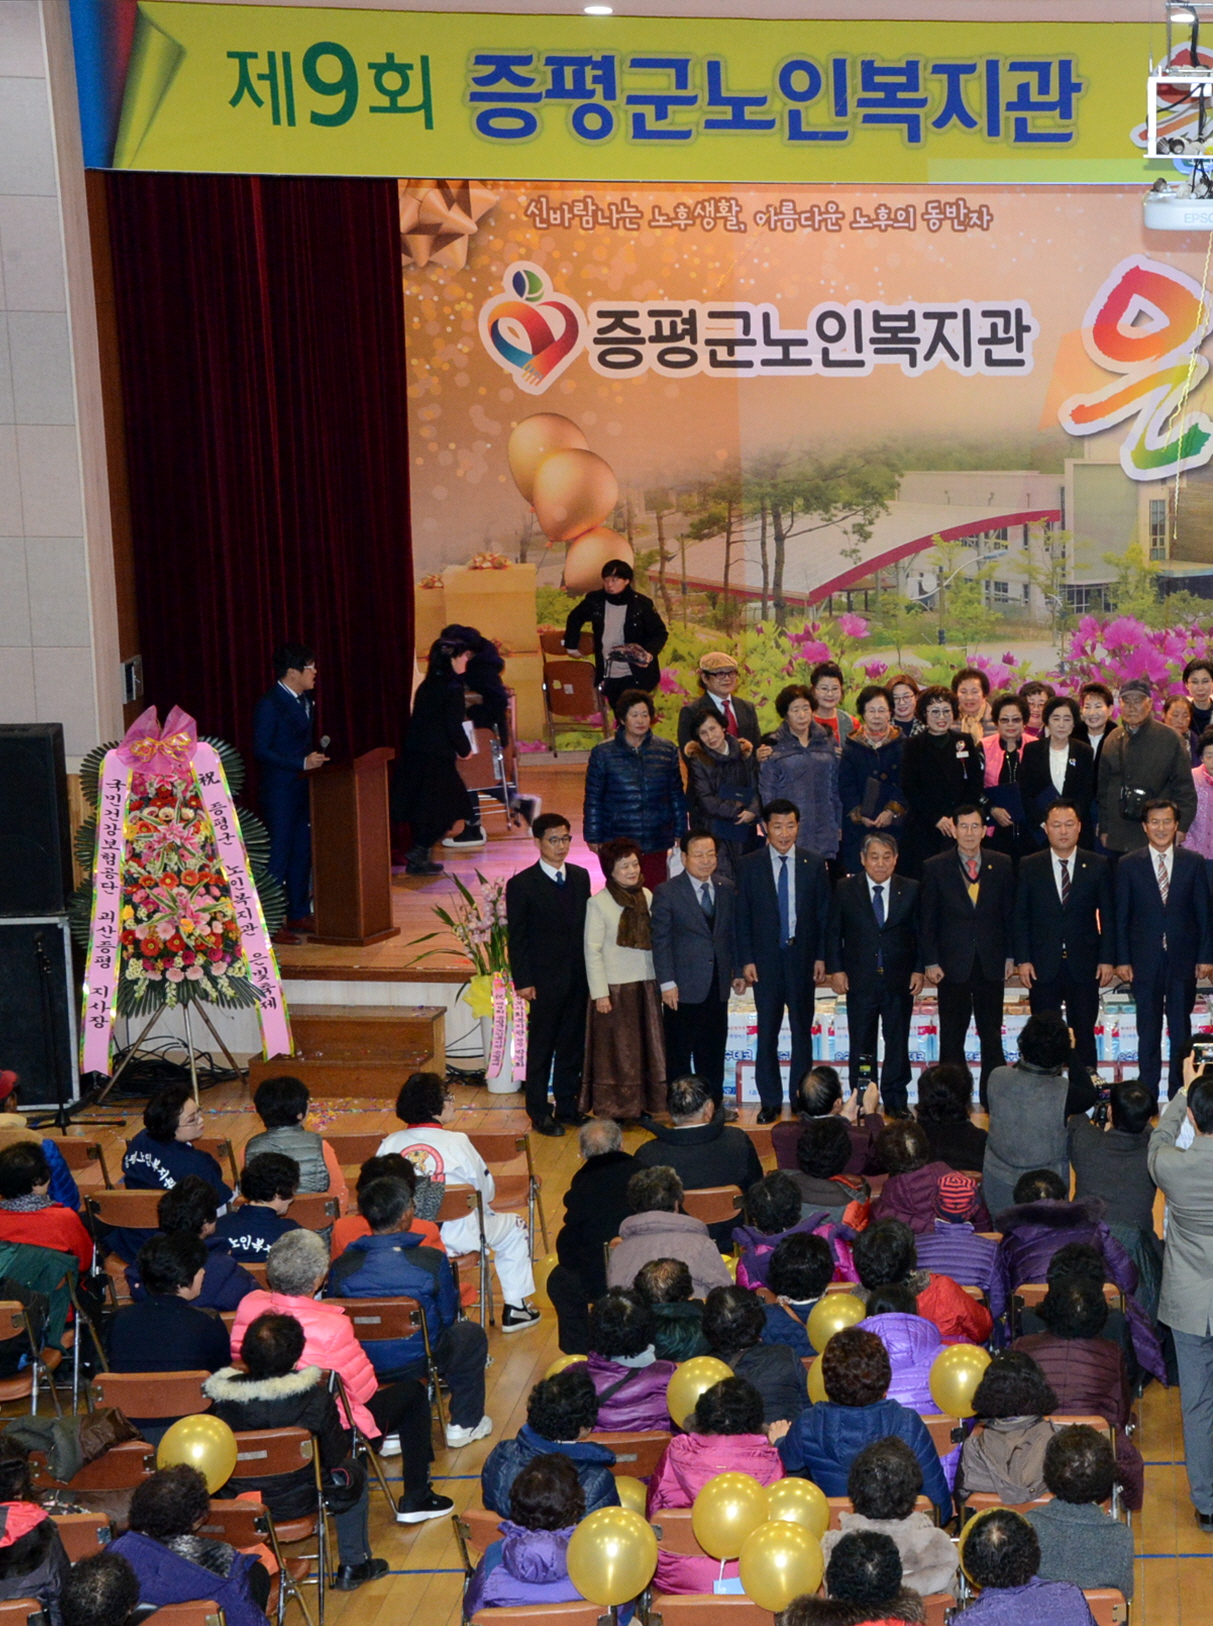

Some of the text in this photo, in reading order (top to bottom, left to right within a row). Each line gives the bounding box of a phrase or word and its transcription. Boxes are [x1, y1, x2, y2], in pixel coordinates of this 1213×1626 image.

[226, 41, 435, 130] 제9회
[469, 54, 1083, 144] 증평군노인복지관
[525, 196, 642, 231] 신바람나는
[755, 200, 844, 231] 아름다운
[851, 204, 916, 231] 노후의
[923, 199, 993, 231] 동반자
[593, 309, 1032, 370] 증평군노인복지관
[89, 779, 127, 1029] 국민건강보험공단 괴산증평 지사장
[198, 771, 220, 787] 祝
[209, 802, 235, 846] 증평군
[226, 865, 259, 936] 노인복지관
